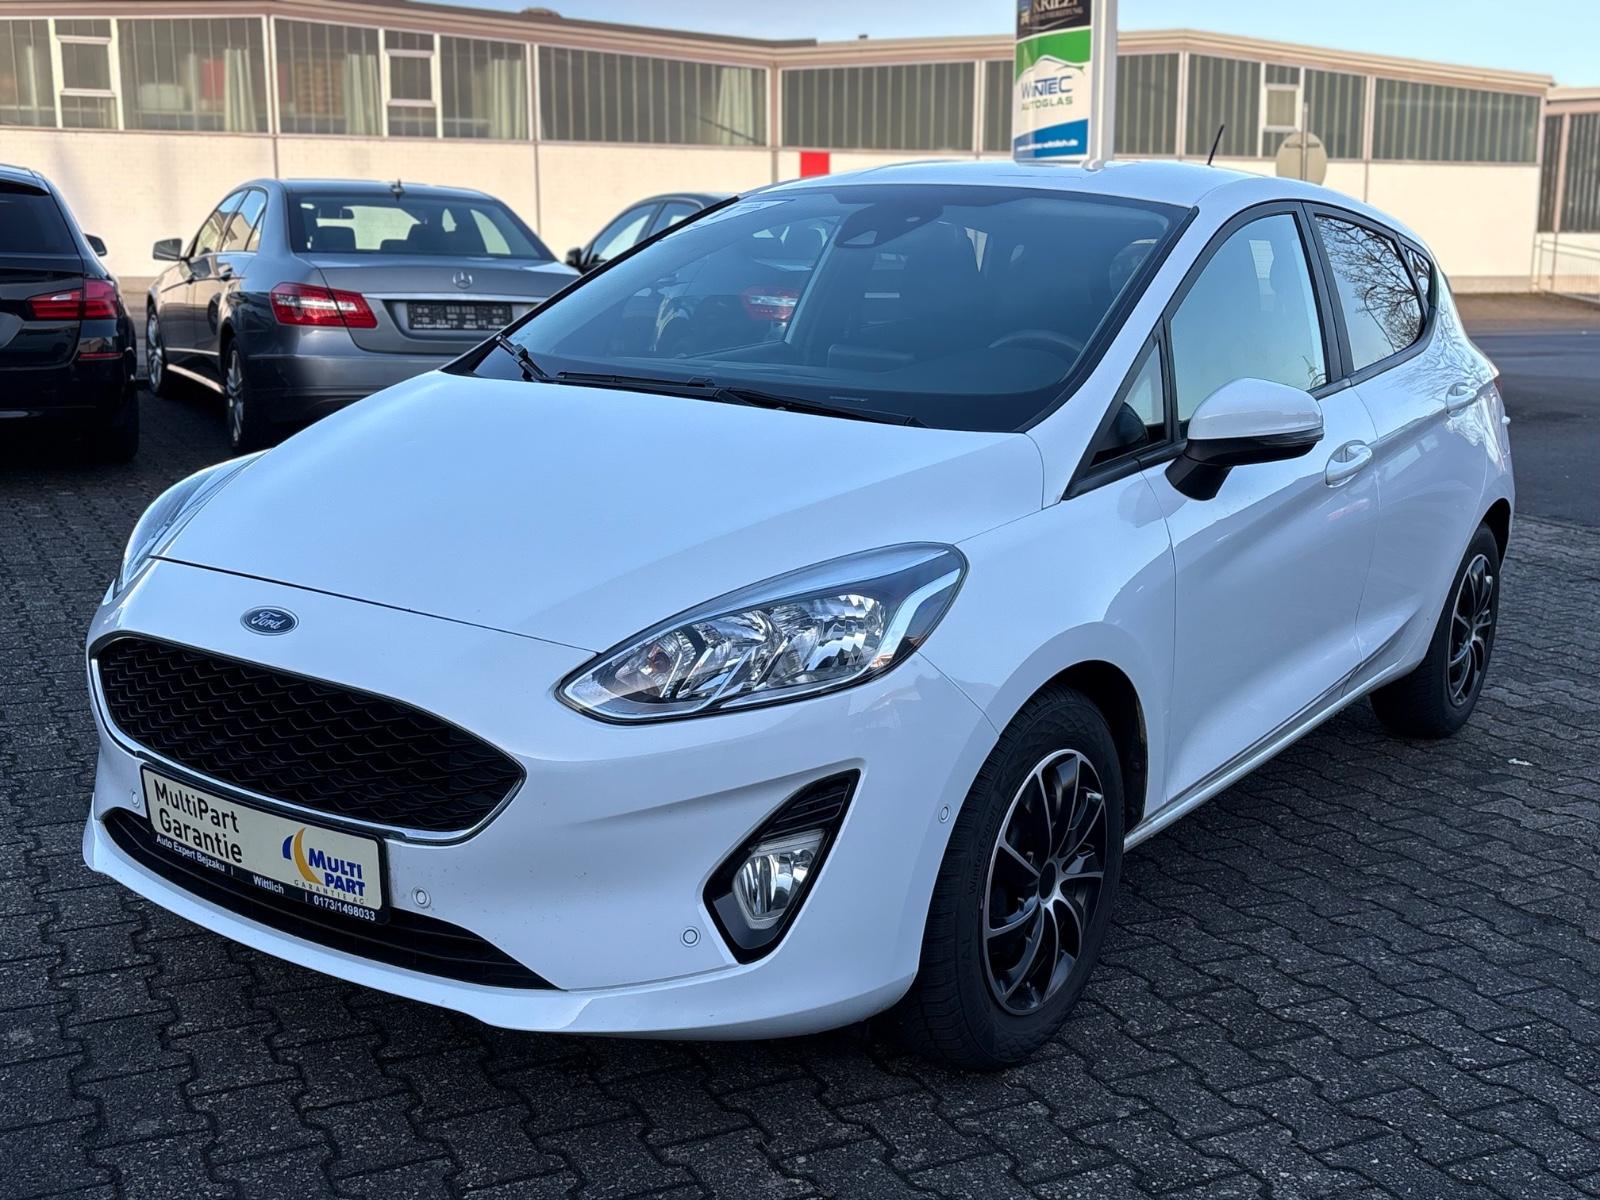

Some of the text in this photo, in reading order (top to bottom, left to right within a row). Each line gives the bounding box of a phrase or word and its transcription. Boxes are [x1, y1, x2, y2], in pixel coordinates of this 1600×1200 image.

[1021, 96, 1073, 110] AUTOGLAS
[251, 611, 286, 630] Ford
[154, 779, 240, 834] MultiPart
[159, 808, 243, 864] Garantie
[156, 833, 376, 922] Auto Expert Bejzaku Wittlich 0173/1498033
[325, 872, 366, 897] PART
[294, 880, 347, 901] GARANTIE
